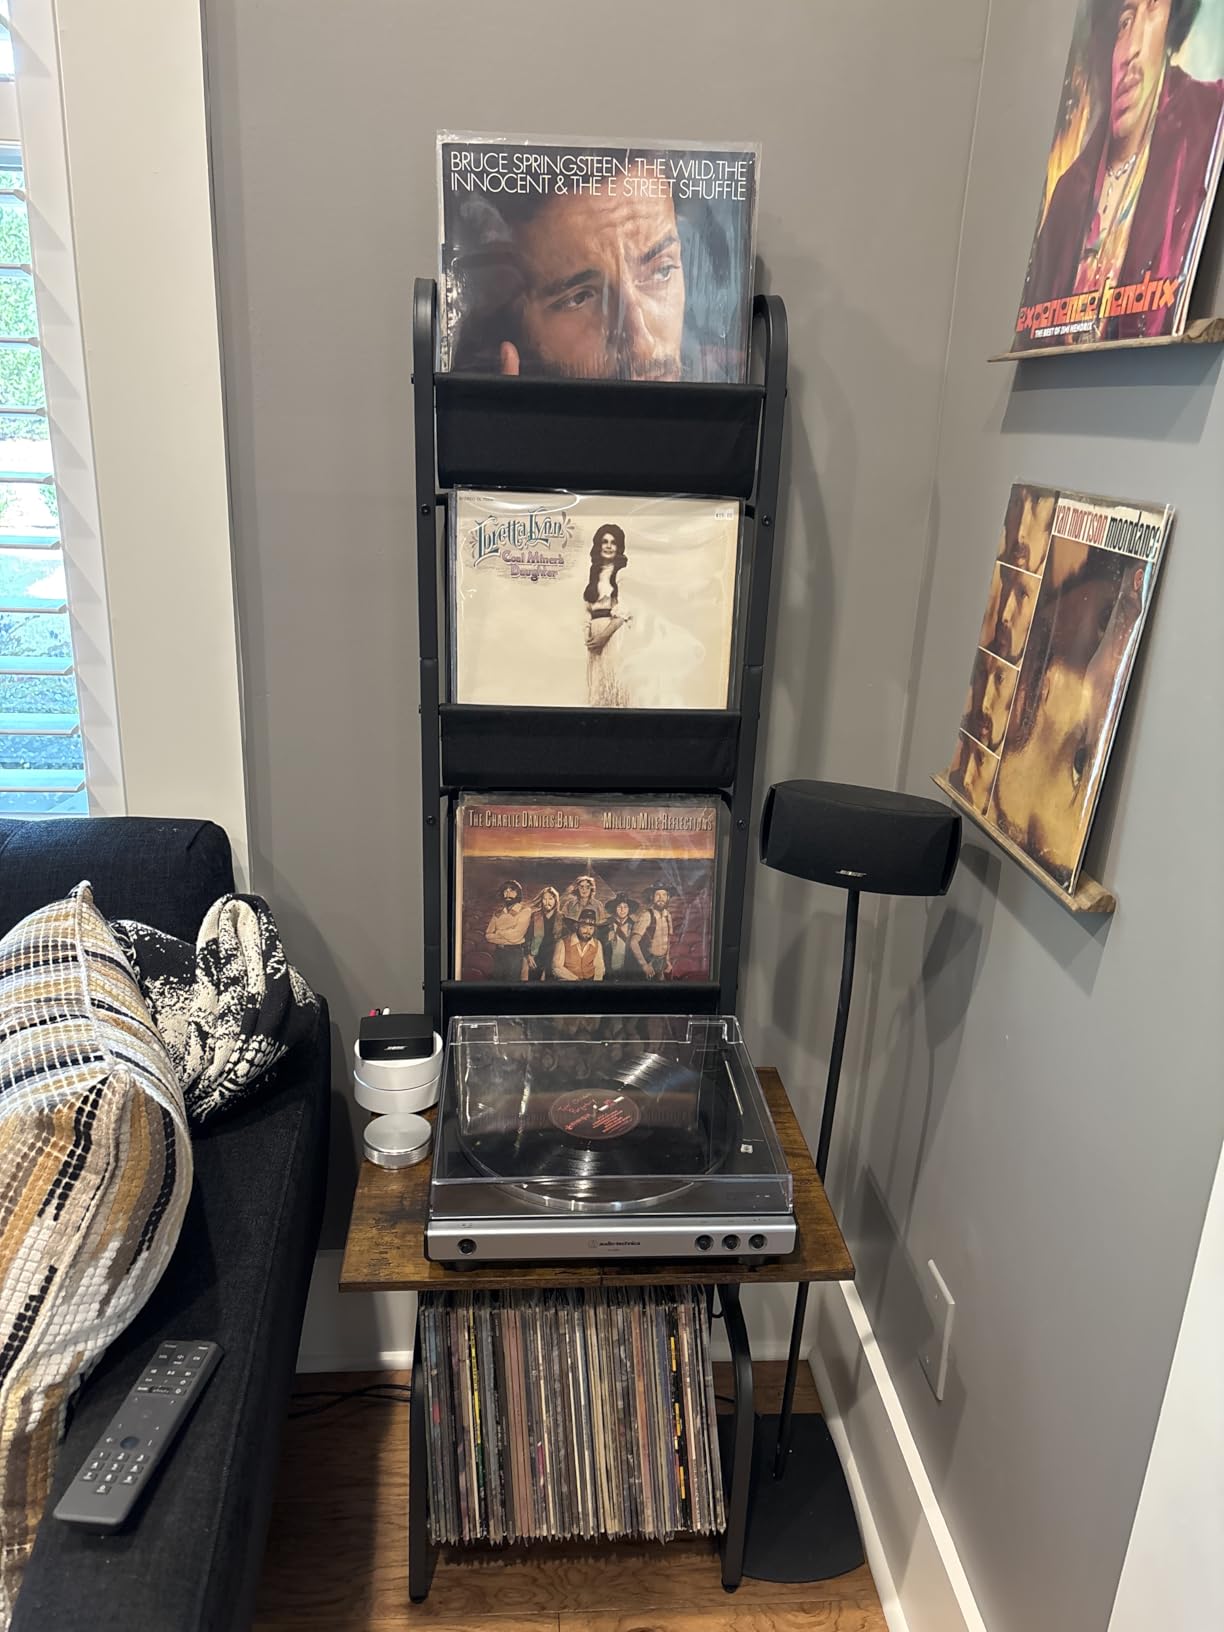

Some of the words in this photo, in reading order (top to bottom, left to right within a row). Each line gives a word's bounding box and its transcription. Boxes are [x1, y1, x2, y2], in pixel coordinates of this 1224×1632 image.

[450, 151, 509, 173] BRUCE
[513, 153, 632, 177] SPRINGSTEEN:
[635, 157, 666, 178] THE
[715, 160, 747, 180] THE
[450, 172, 552, 194] INNOCENT
[554, 175, 569, 195] &
[570, 176, 602, 196] THE
[608, 177, 617, 196] E
[623, 178, 677, 198] STREET
[678, 180, 747, 201] SHUFFLE
[474, 515, 526, 567] Loretta
[1066, 507, 1109, 546] morrison
[1103, 516, 1162, 560] moondance
